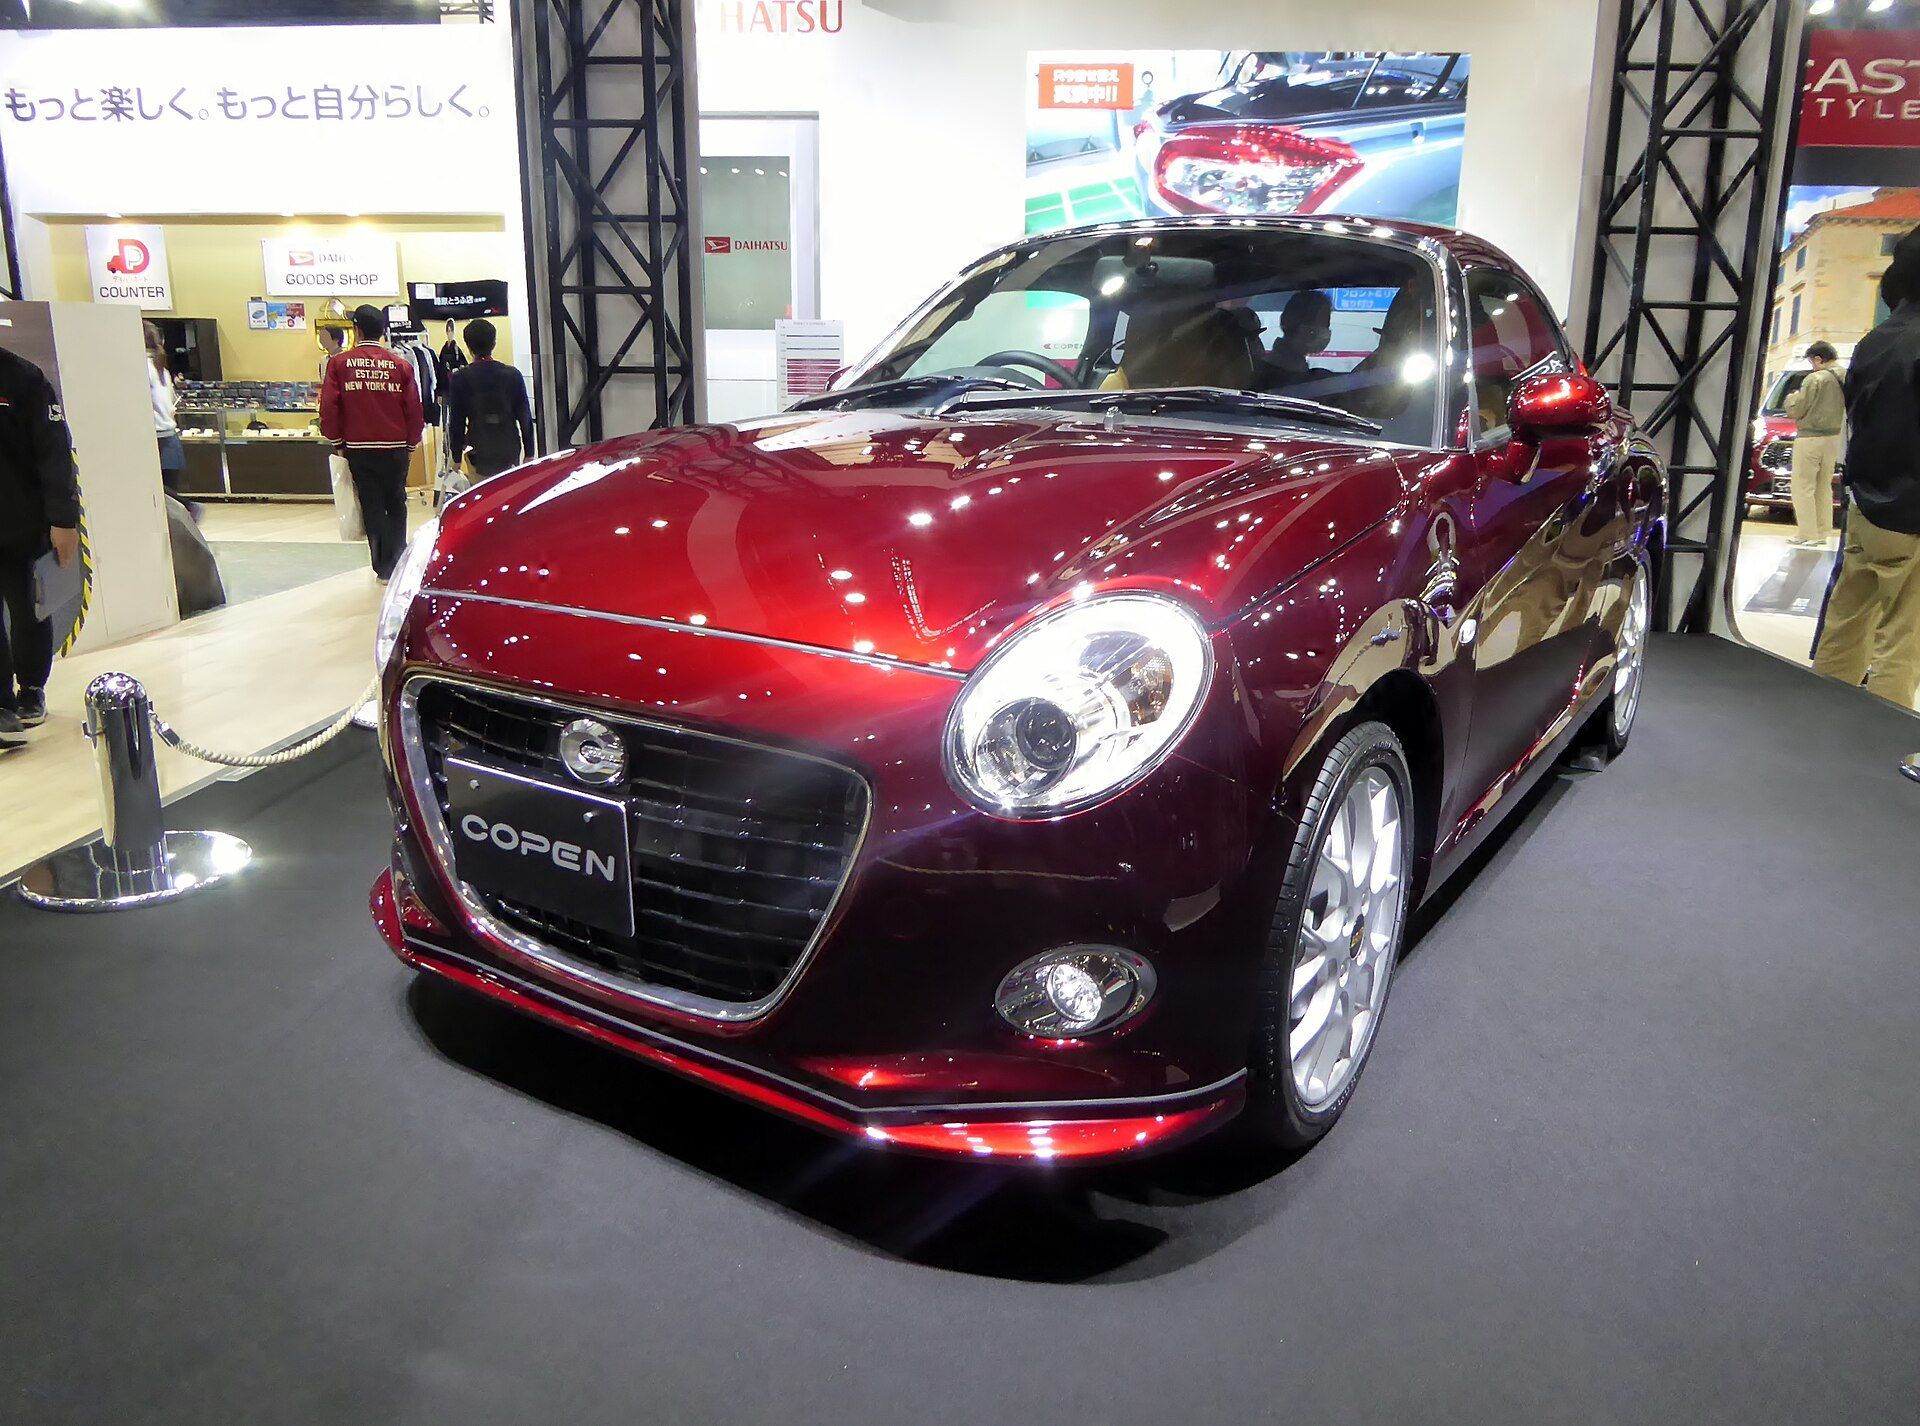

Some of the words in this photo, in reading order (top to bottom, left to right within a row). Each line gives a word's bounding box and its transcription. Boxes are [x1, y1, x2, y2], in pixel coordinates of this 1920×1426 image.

[720, 0, 844, 33] HATSU
[1803, 58, 1920, 94] AS
[4, 84, 490, 122] もっと楽しく。もっと自分らしく。
[1800, 98, 1920, 119] TYLE
[734, 240, 788, 251] DAIHATSU
[286, 273, 335, 286] GOODS
[340, 274, 378, 286] SHOP
[100, 286, 165, 298] COUNTER
[346, 358, 376, 368] AVIREX
[377, 359, 397, 369] MFG.
[345, 381, 363, 391] NEW
[364, 381, 387, 391] YORK
[388, 382, 403, 393] N.Y.
[461, 814, 615, 882] COPEN
